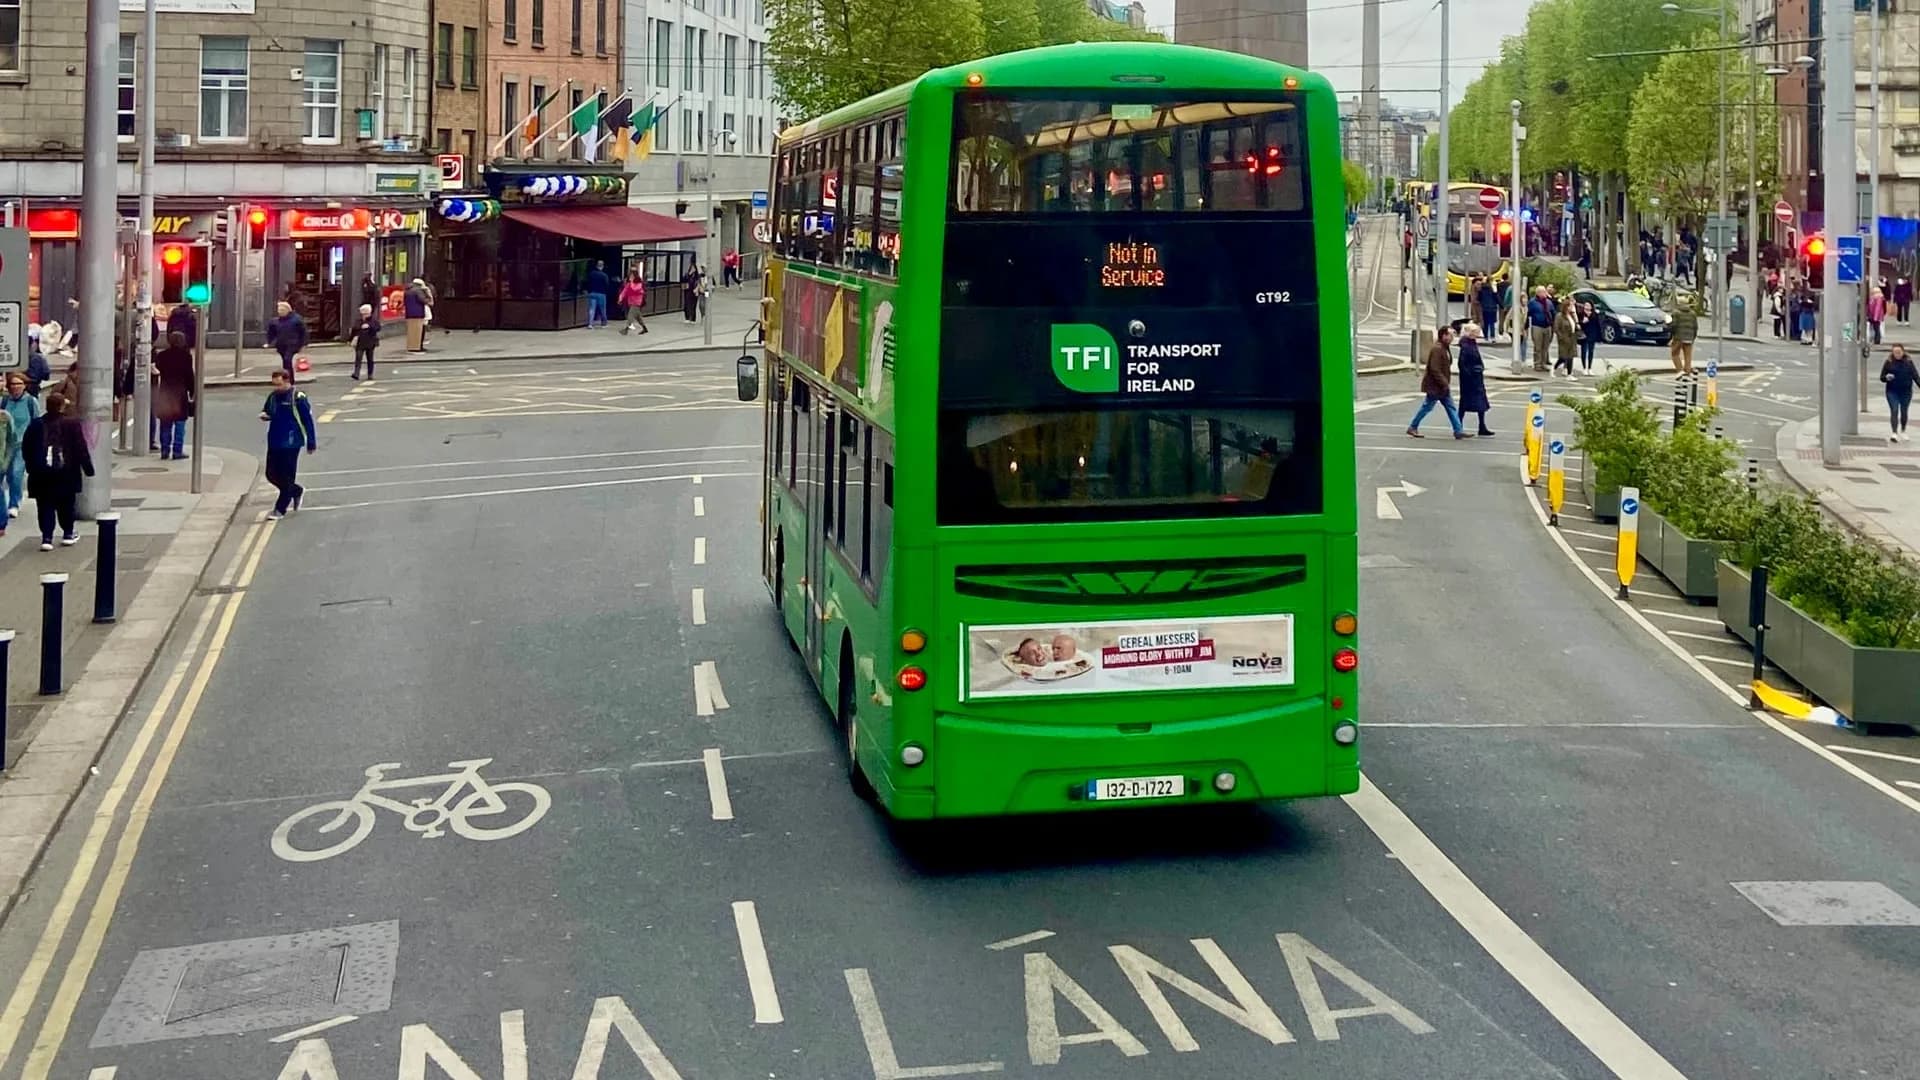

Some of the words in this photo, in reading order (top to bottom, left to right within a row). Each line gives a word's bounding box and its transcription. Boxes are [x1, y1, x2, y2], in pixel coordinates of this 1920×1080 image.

[1110, 242, 1138, 264] Not
[1143, 242, 1157, 264] in
[1102, 265, 1165, 287] Service
[1256, 291, 1291, 303] GT92
[1060, 346, 1111, 370] TFI
[1127, 344, 1222, 358] TRANSPORT
[1127, 362, 1160, 375] FOR
[1127, 378, 1196, 393] IRELAND
[1120, 637, 1154, 649] CEREAL
[1155, 632, 1197, 646] MESSERS
[1103, 652, 1139, 665] MORNING
[1139, 650, 1164, 662] GLORY
[1164, 648, 1184, 661] WITH
[1106, 780, 1173, 797] 132-D-1722
[843, 929, 1437, 1080] LÁNA
